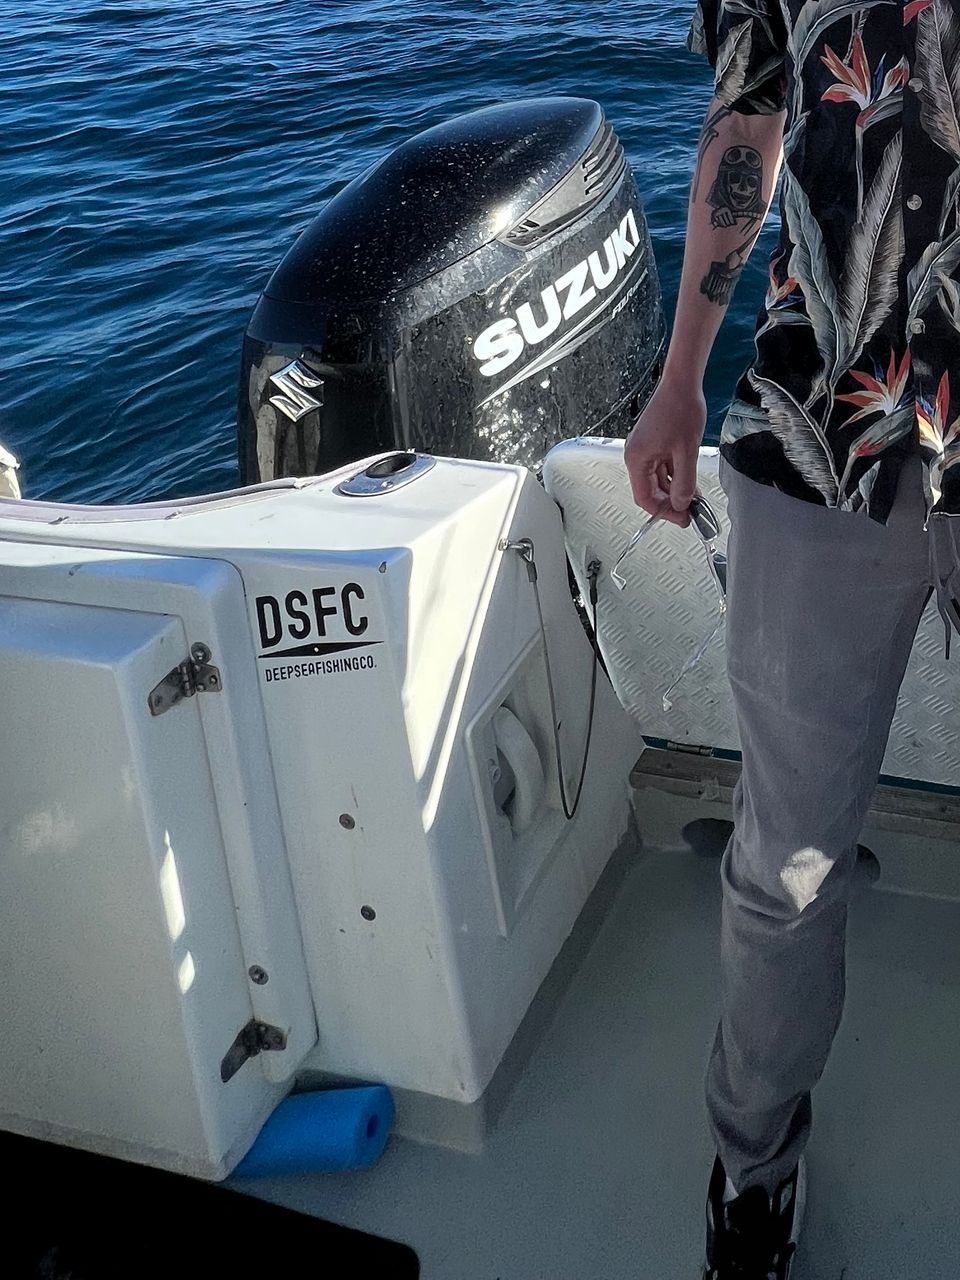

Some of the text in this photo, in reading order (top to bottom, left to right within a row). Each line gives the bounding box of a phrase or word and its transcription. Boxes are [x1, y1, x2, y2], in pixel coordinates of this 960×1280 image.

[473, 208, 641, 377] SUZUKI
[256, 582, 368, 649] DSFC
[265, 655, 377, 682] DEEPSEAFISHINGCO.
